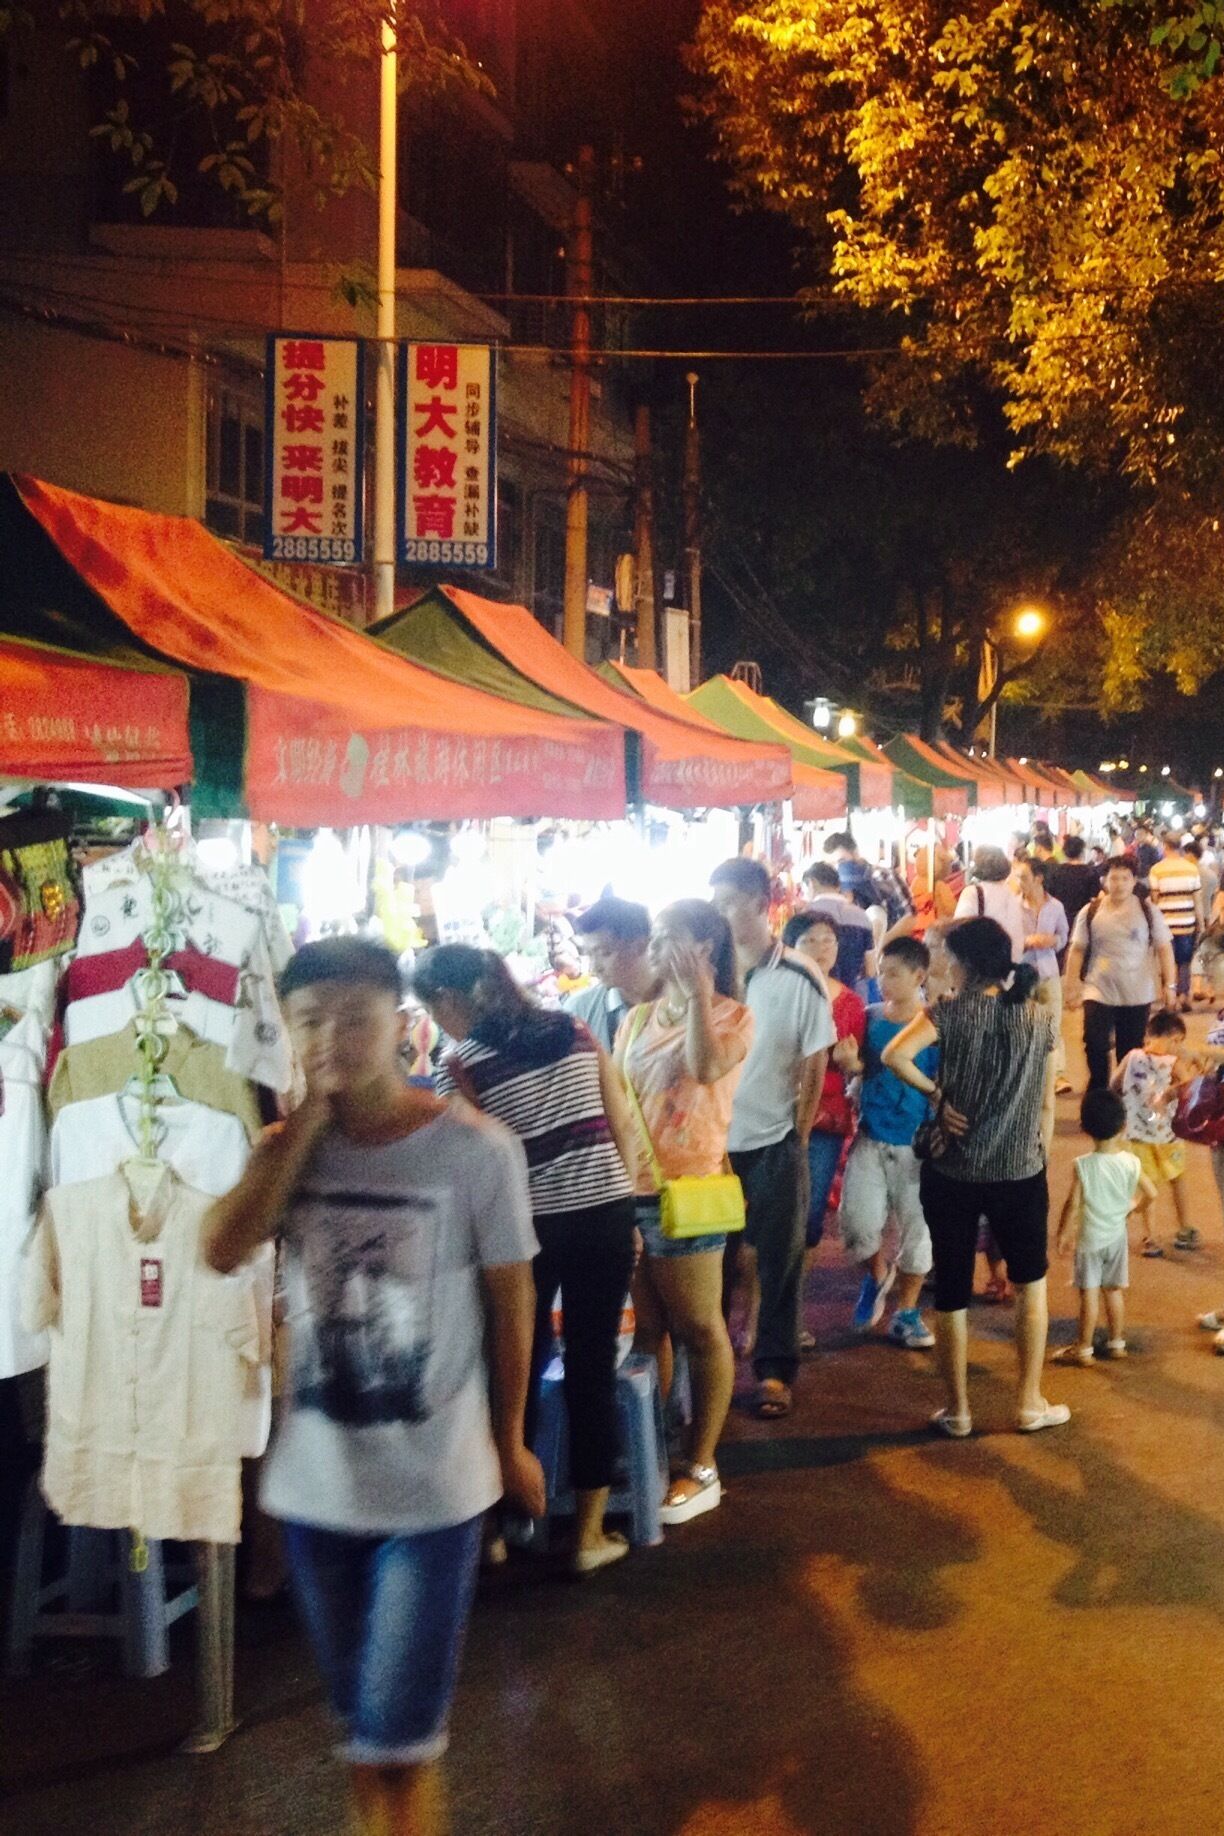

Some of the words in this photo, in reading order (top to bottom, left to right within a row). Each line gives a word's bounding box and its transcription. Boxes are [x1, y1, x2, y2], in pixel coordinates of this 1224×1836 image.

[413, 345, 457, 540] 明大教育
[272, 537, 355, 561] 2885559
[405, 541, 489, 565] 2885559
